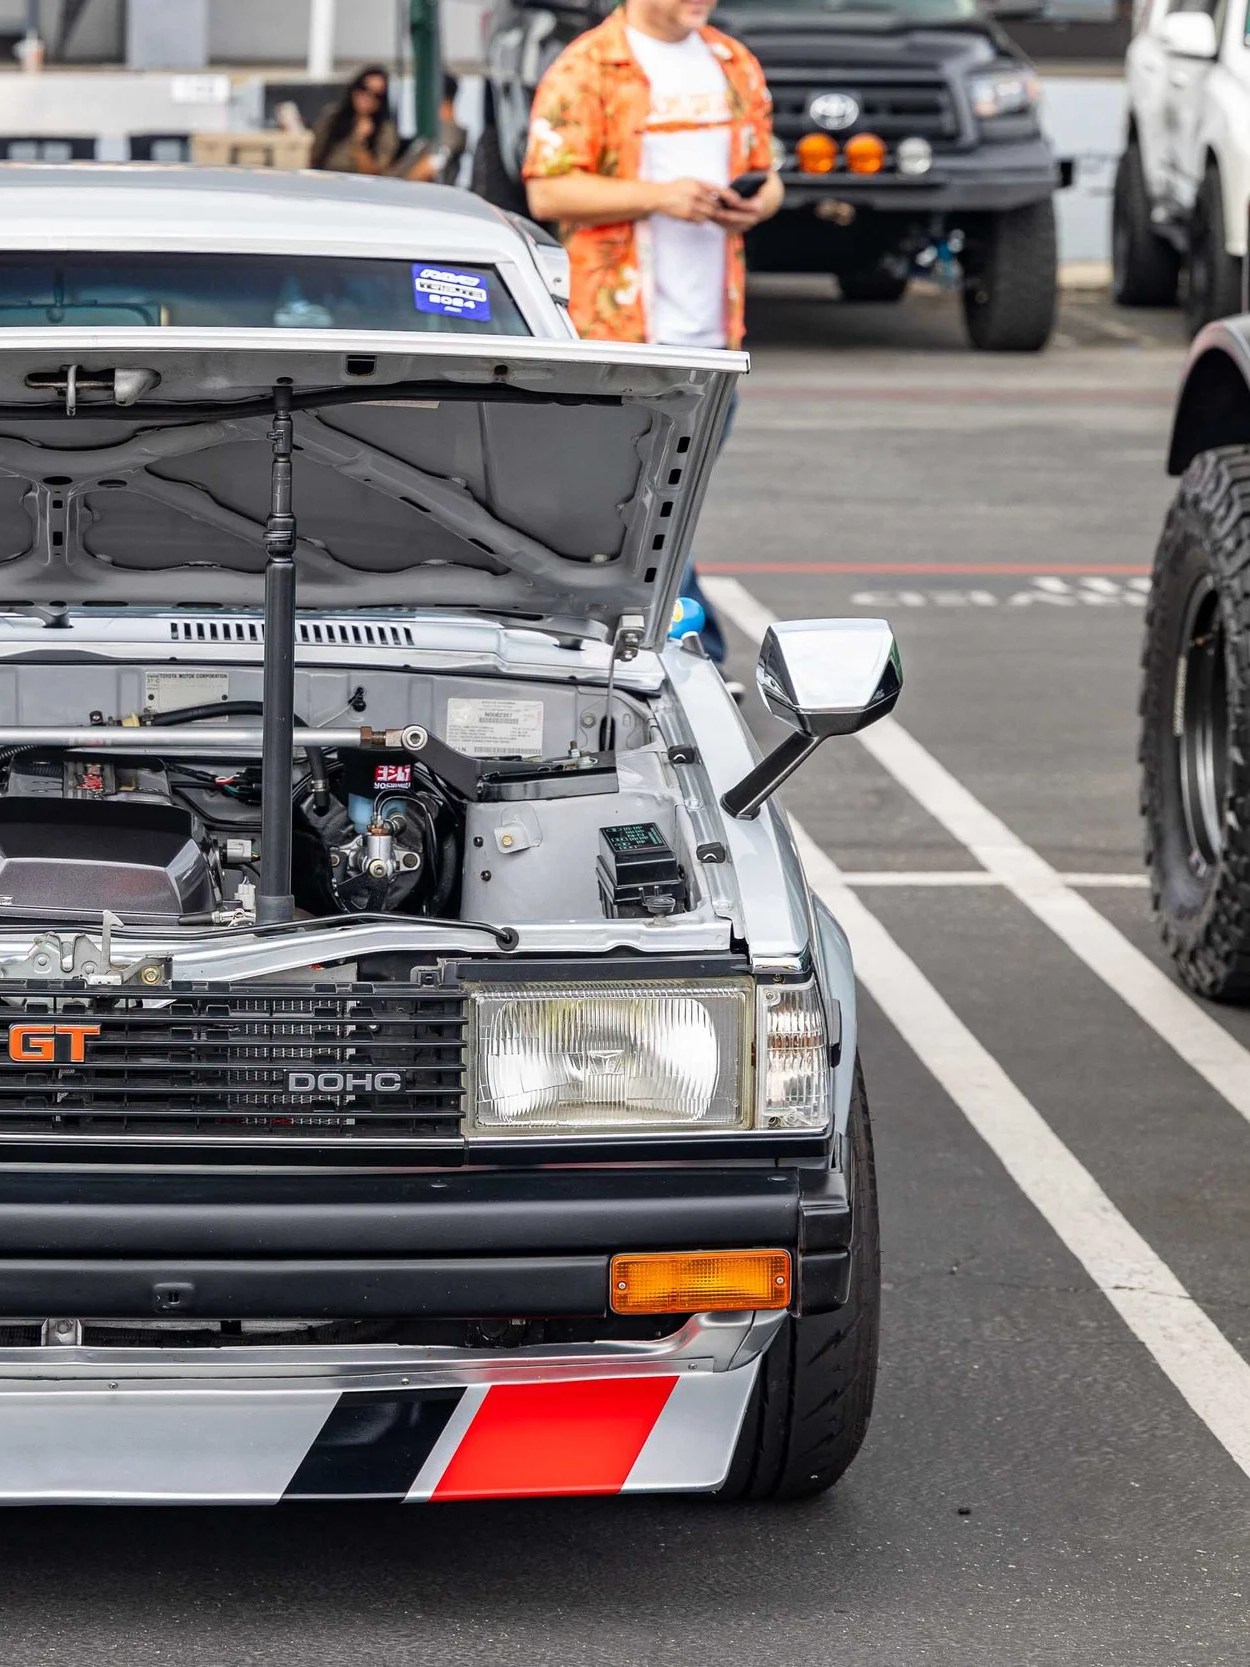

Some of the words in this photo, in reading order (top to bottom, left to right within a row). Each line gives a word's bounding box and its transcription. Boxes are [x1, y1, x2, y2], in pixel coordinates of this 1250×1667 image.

[429, 294, 476, 309] 2024
[7, 1022, 101, 1063] GT
[287, 1072, 402, 1093] DOHC
